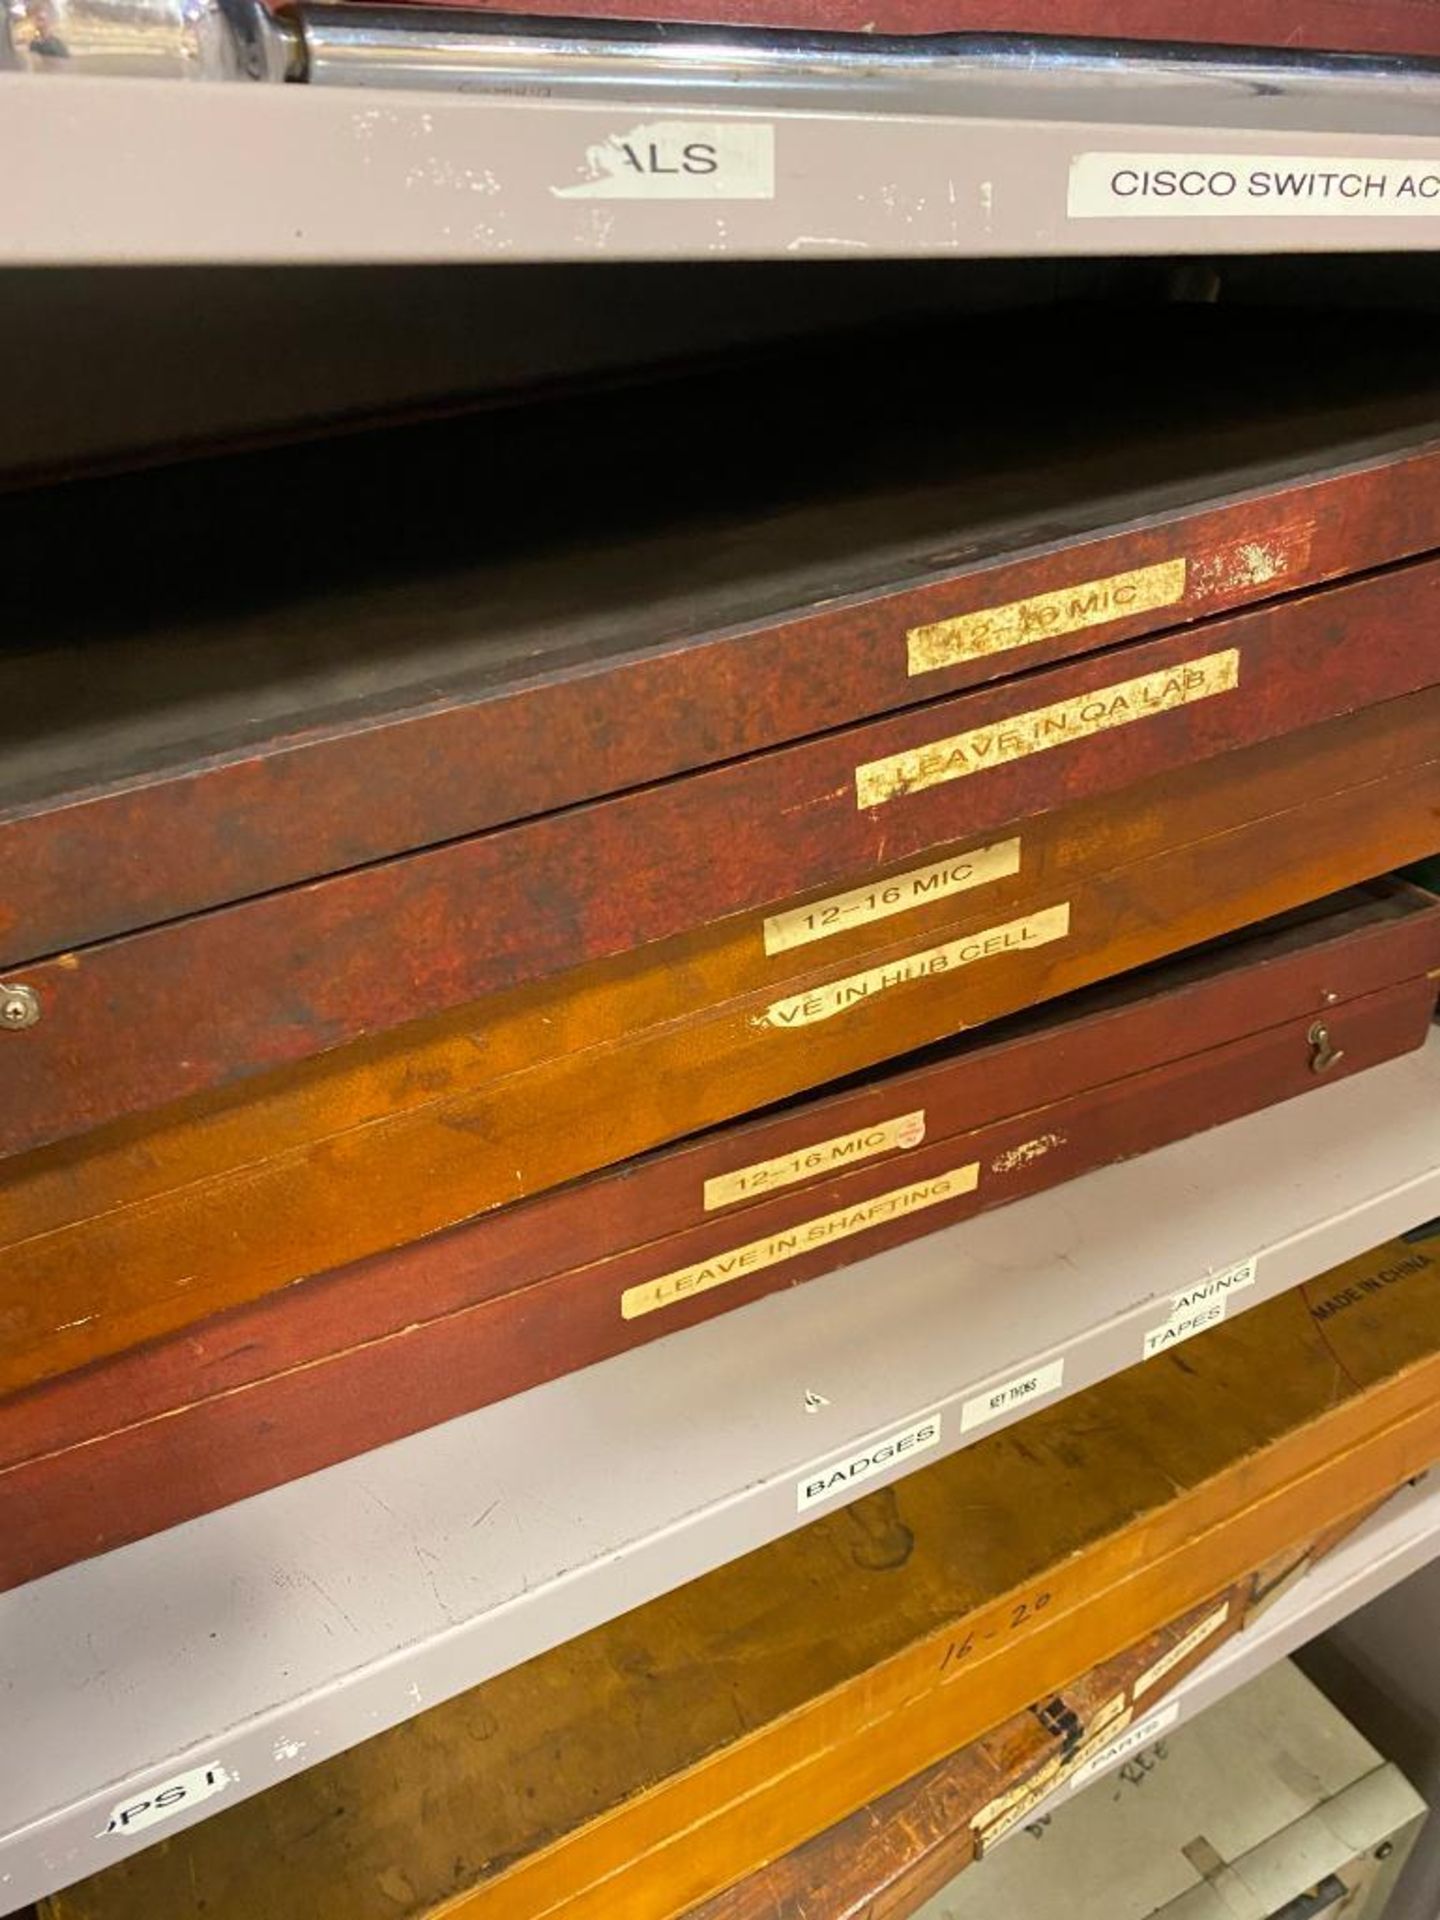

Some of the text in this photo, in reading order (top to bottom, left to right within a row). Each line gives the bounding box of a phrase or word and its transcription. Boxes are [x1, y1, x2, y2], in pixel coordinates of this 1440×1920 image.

[1110, 170, 1237, 197] CISCO
[1248, 172, 1388, 198] SWITCH
[1069, 584, 1138, 620] MIC
[895, 669, 1206, 787] LEAVE IN QA LAB
[803, 863, 974, 931] 12-16 MIC
[836, 982, 869, 1005] IN
[881, 955, 949, 990] HUB
[959, 926, 1038, 962] CELL
[735, 1131, 887, 1190] 12-16 MIC
[653, 1180, 953, 1301] LEAVE IN SHAFTING
[1309, 1253, 1434, 1322] MADE IN CHINA
[1147, 1304, 1222, 1349] TAPES
[805, 1424, 935, 1499] BADGES
